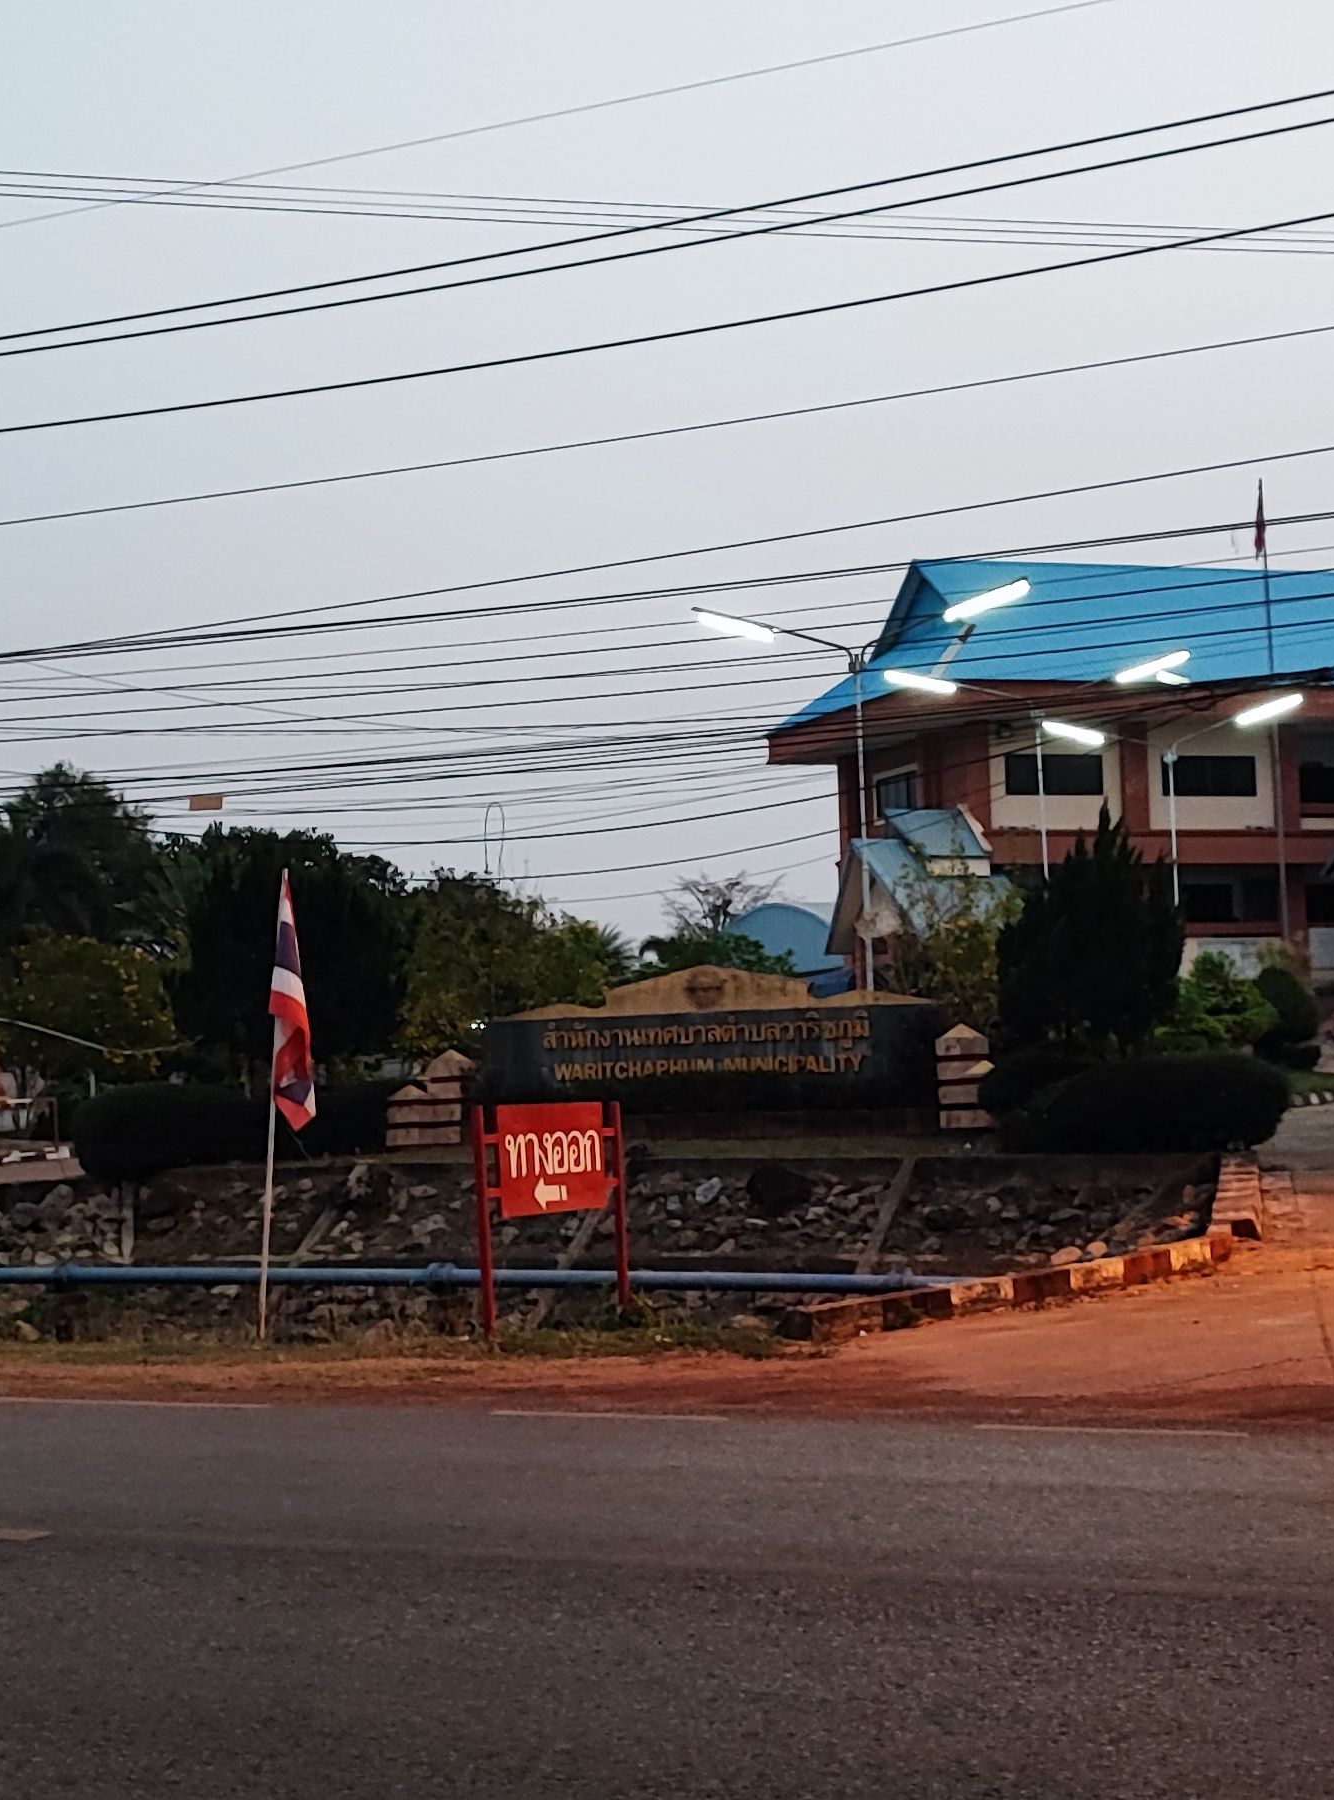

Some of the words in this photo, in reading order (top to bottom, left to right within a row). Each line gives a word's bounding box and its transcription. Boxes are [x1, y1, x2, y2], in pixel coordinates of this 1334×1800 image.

[542, 1010, 870, 1050] สำนักงานเทศบาลตำบลวาริชภูมิ
[504, 1129, 602, 1179] ทางออก
